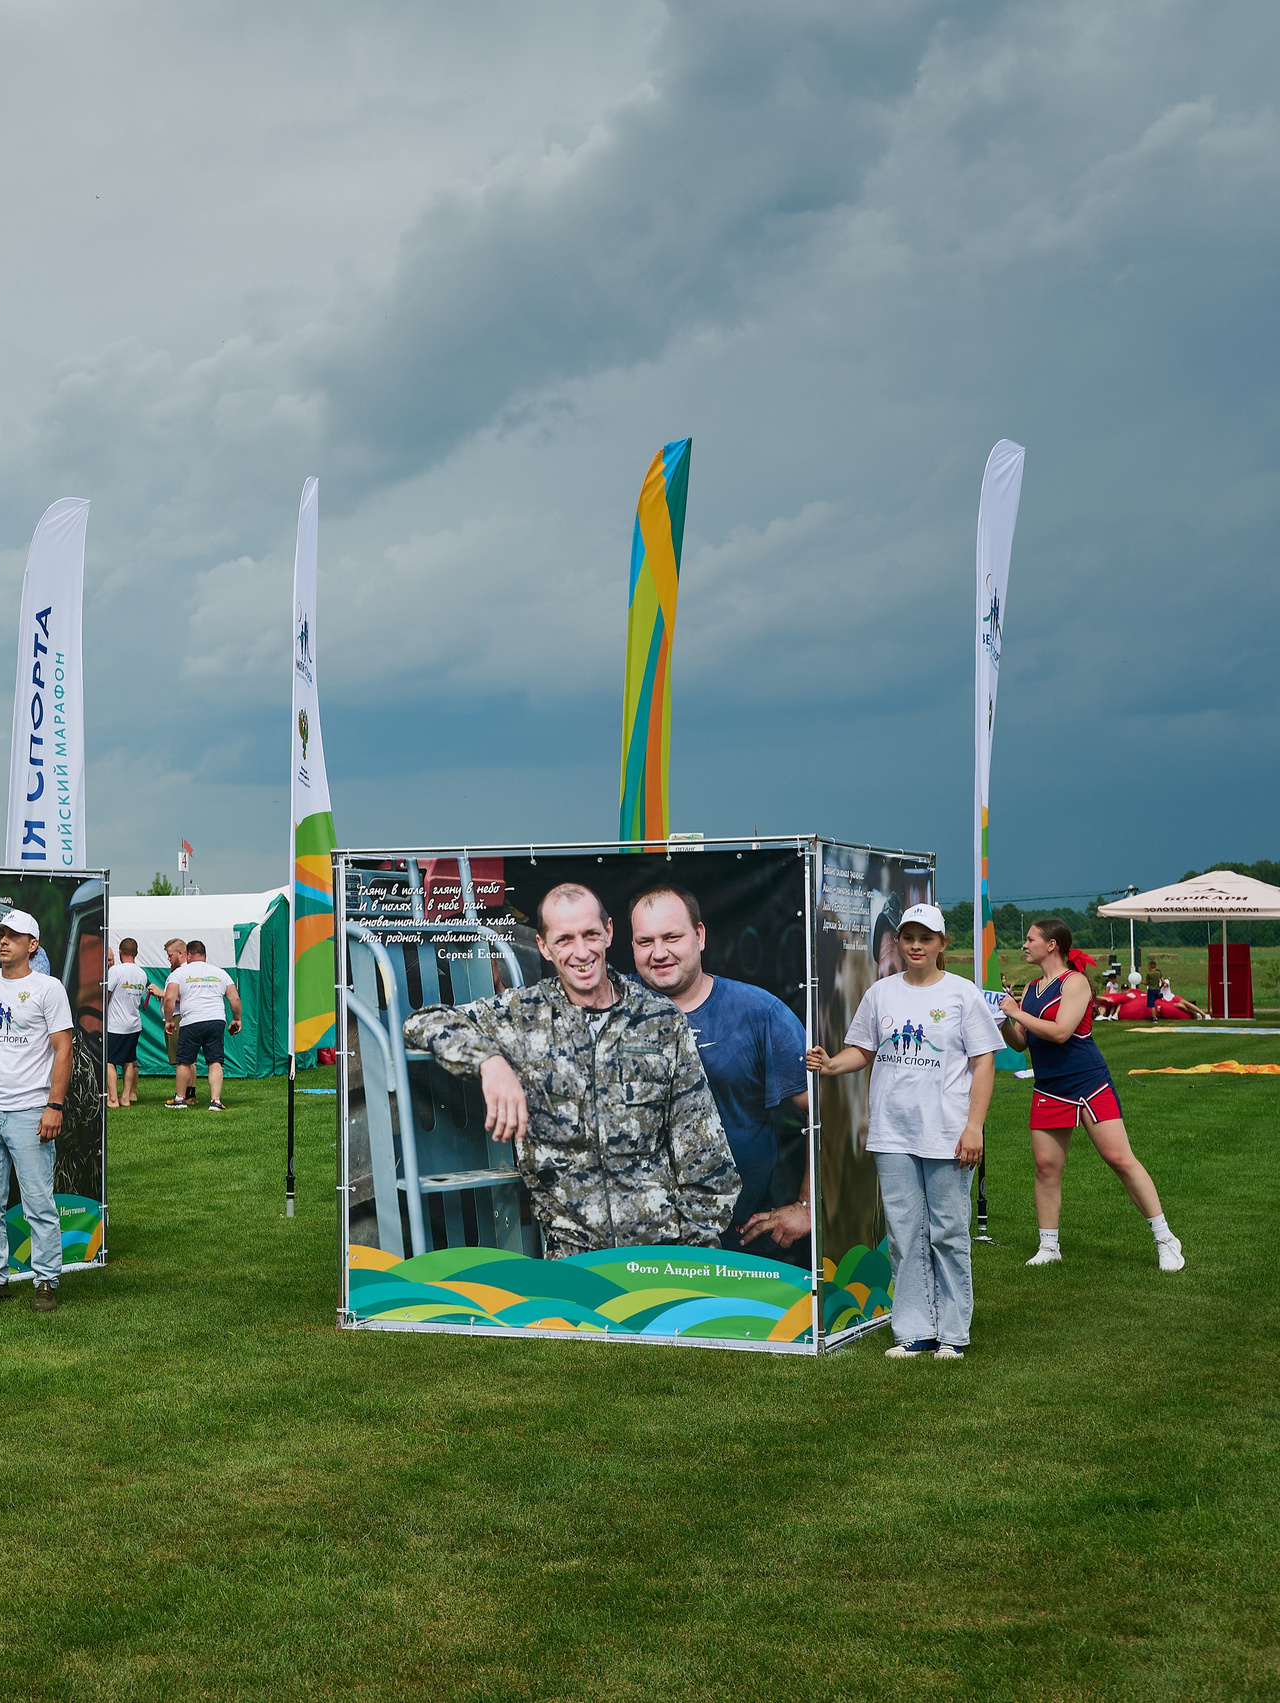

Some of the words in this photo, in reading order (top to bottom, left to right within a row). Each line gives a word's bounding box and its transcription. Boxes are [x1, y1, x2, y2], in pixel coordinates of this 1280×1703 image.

[27, 606, 52, 802] СПОРТА
[54, 652, 68, 757] МАРАФОН
[53, 764, 74, 866] СИЙСКИЙ
[182, 853, 188, 868] 4
[357, 883, 387, 900] Гляну
[391, 882, 397, 896] в
[402, 886, 428, 898] поле,
[432, 886, 462, 900] гляну
[466, 882, 473, 894] в
[476, 880, 501, 894] небо
[358, 902, 367, 911] И
[371, 900, 378, 911] в
[381, 902, 412, 912] полях
[415, 902, 422, 910] и
[427, 899, 433, 910] в
[438, 898, 460, 910] небе
[462, 900, 487, 915] рай.
[358, 914, 390, 927] Снова
[394, 918, 431, 927] тонет
[434, 914, 440, 926] в
[444, 918, 482, 927] копнах
[486, 914, 517, 926] хлеба
[358, 932, 382, 944] Мой
[385, 931, 424, 947] родной,
[429, 930, 482, 943] любимый
[485, 932, 516, 947] край.
[438, 949, 474, 961] Сергей
[478, 949, 515, 960] Есенин
[904, 1056, 940, 1068] СПОРТА
[626, 1261, 659, 1274] Фото
[664, 1262, 710, 1278] Андрей
[715, 1264, 780, 1280] Ишутинов
